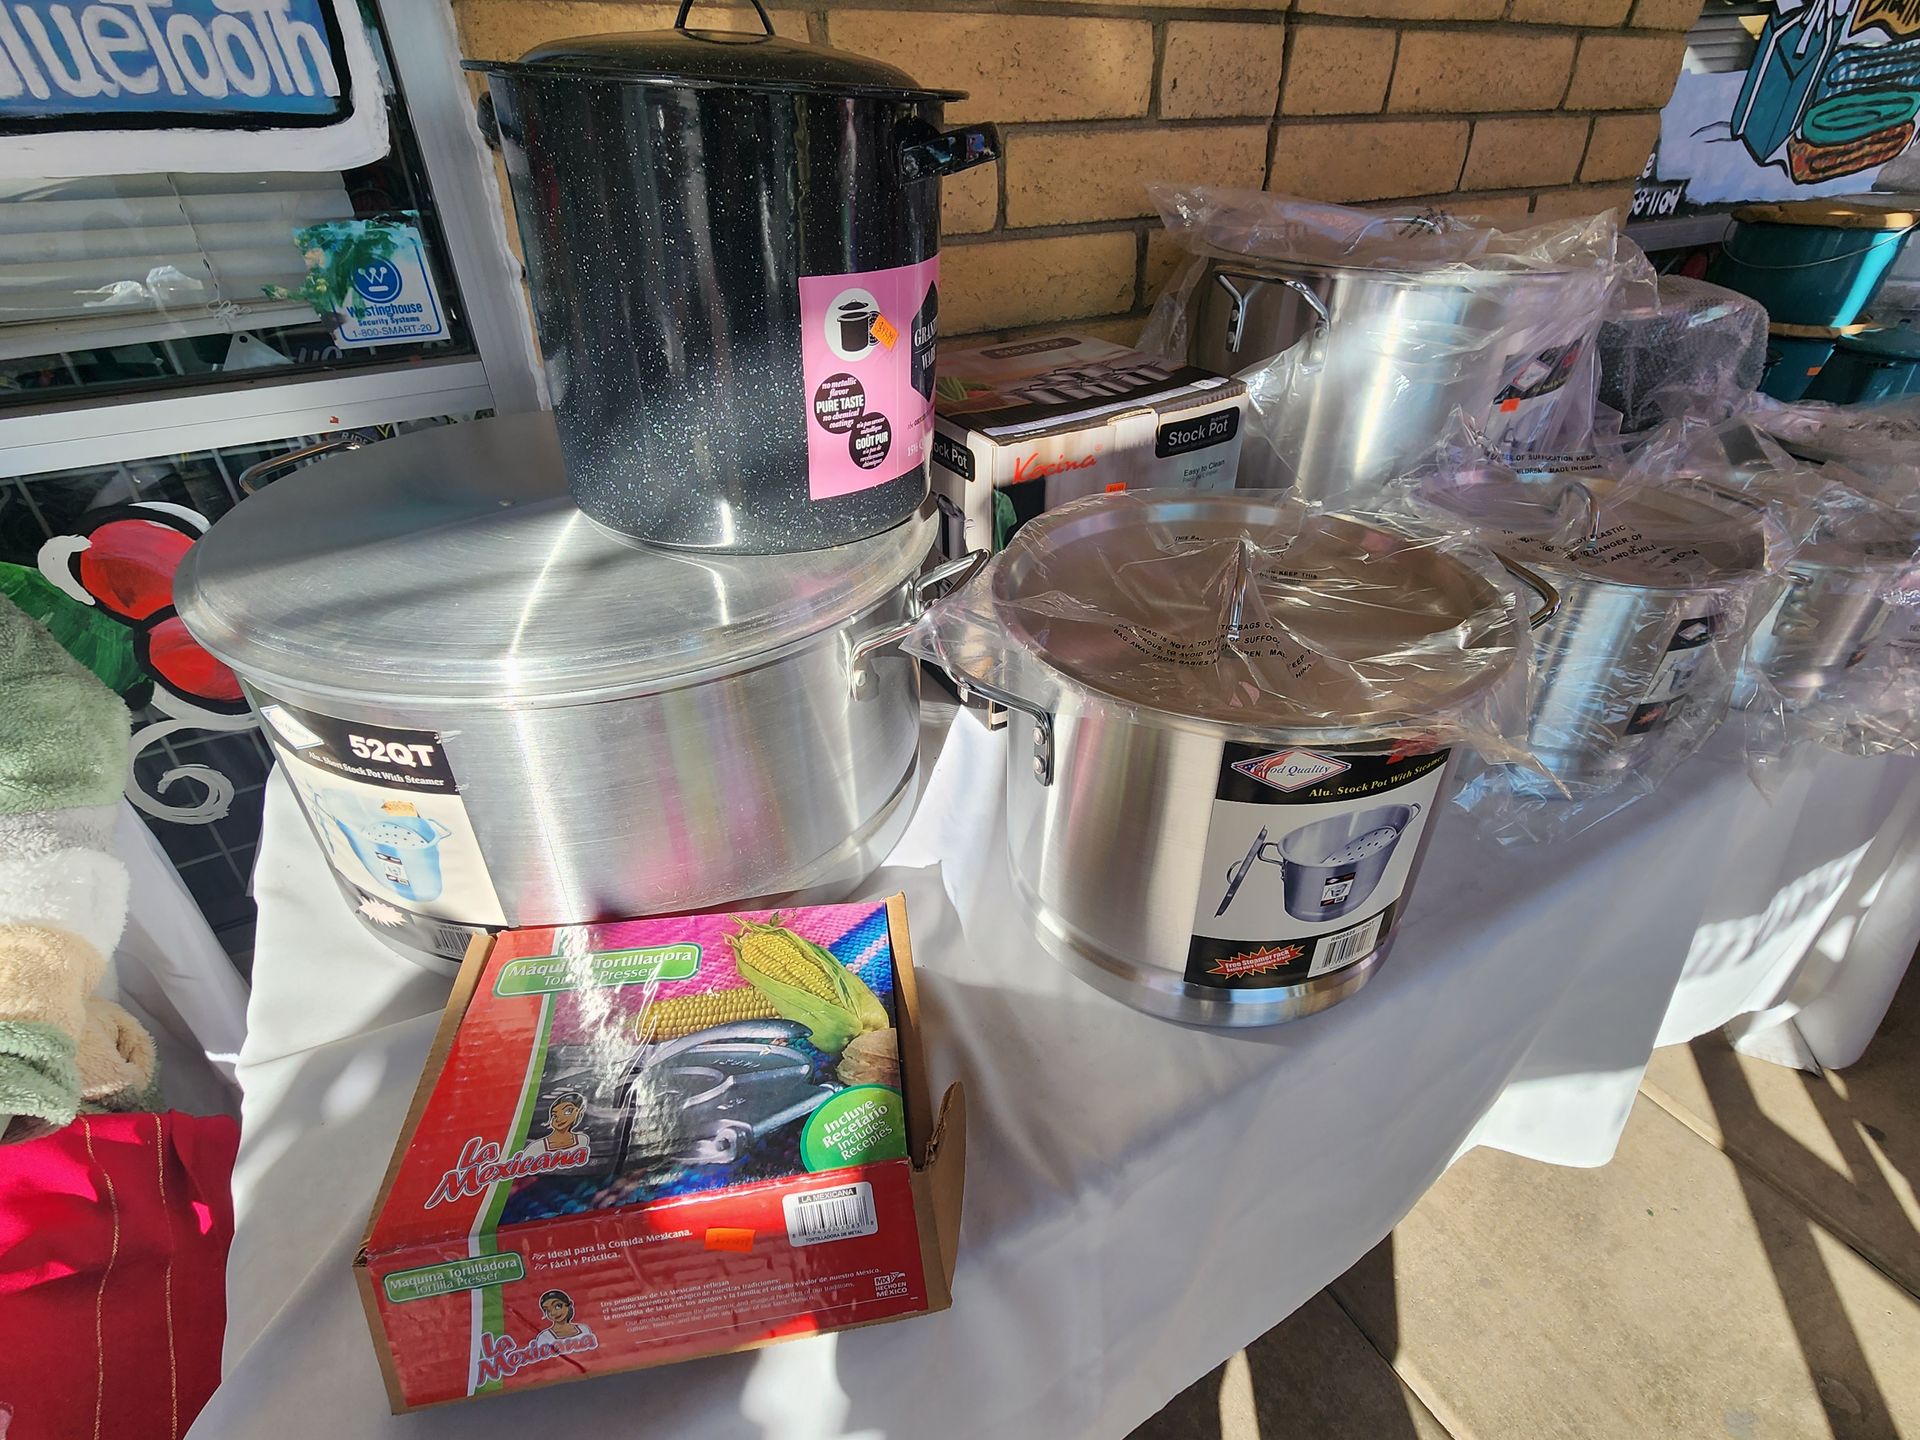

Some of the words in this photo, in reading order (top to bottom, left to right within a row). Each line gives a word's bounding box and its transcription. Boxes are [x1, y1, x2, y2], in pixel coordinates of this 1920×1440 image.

[352, 323, 432, 338] 1-800-SMART-20
[358, 318, 389, 327] Security
[390, 315, 420, 325] Systems
[831, 377, 857, 388] metallic
[828, 388, 849, 399] flavor
[816, 399, 840, 413] PURE
[840, 395, 864, 410] TASTE
[832, 408, 860, 420] chemical
[829, 420, 854, 429] coatings
[1168, 425, 1206, 446] Stock
[1208, 419, 1228, 437] Pot
[856, 434, 875, 450] GOÛT
[875, 431, 889, 444] PUR
[952, 448, 968, 470] Pot
[1012, 453, 1096, 485] Kocina
[1183, 467, 1199, 477] Easy
[1201, 464, 1208, 472] to
[1208, 459, 1226, 469] Clean
[1590, 524, 1626, 540] PLASTIC
[1592, 537, 1629, 555] DANGER
[1610, 552, 1629, 562] AND
[1113, 628, 1129, 642] BAG
[1130, 641, 1150, 655] AWAY
[1152, 653, 1175, 663] FROM
[1141, 627, 1158, 638] BAG
[1160, 635, 1168, 643] IS
[1169, 640, 1187, 650] NOT
[1197, 639, 1213, 647] TOY
[1237, 622, 1260, 631] BAGS
[348, 735, 434, 768] 52QT
[323, 756, 344, 770] Short
[343, 763, 368, 776] Stock
[366, 768, 381, 780] Pot
[381, 771, 404, 782] With
[405, 775, 444, 786] Steamer
[1286, 764, 1331, 777] Quality
[1309, 788, 1334, 798] Alu.
[1337, 783, 1368, 795] Stock
[1370, 778, 1388, 790] Pot
[1390, 770, 1413, 785] With
[1413, 754, 1446, 776] Steamer
[594, 950, 692, 970] Tortilladora
[1225, 960, 1242, 969] Free
[1242, 955, 1273, 967] Steamer
[1273, 949, 1291, 961] rack
[600, 965, 656, 979] Presser
[822, 1105, 888, 1148] Recetario
[823, 1100, 875, 1134] Incluye
[837, 1119, 886, 1151] Includes
[841, 1126, 893, 1161] Recepies
[456, 1136, 500, 1172] La
[424, 1147, 590, 1210] Mexicana
[800, 1195, 812, 1204] LA
[812, 1188, 854, 1202] MEXICANA
[547, 1248, 571, 1259] Ideal
[574, 1245, 595, 1259] para
[597, 1242, 606, 1251] la
[608, 1237, 644, 1250] Comida
[646, 1229, 693, 1243] Mexicana.
[806, 1232, 841, 1242] TORTILLADORA
[848, 1229, 863, 1237] METAL
[448, 1258, 517, 1279] Tortilladora
[550, 1258, 571, 1269] Fácil
[573, 1258, 579, 1267] y
[582, 1251, 621, 1263] Práctica.
[415, 1281, 454, 1296] Tortilla
[456, 1272, 500, 1287] Presser
[875, 1276, 890, 1286] MX
[875, 1282, 897, 1292] HECHO
[898, 1281, 907, 1289] EN
[601, 1300, 613, 1308] Los
[614, 1294, 648, 1307] productos
[649, 1290, 658, 1299] de
[669, 1285, 701, 1296] Mexicana
[703, 1279, 730, 1290] reflejan
[603, 1313, 611, 1321] la
[612, 1308, 644, 1321] nostalgia
[645, 1306, 655, 1314] de
[656, 1305, 663, 1313] la
[698, 1294, 723, 1305] amigos
[770, 1283, 794, 1296] orgullo
[801, 1278, 818, 1286] valor
[819, 1275, 828, 1283] de
[830, 1271, 854, 1281] nuestro
[611, 1302, 636, 1313] sentido
[701, 1289, 711, 1297] de
[712, 1284, 741, 1295] nuestras
[876, 1287, 908, 1298] MÉXICO
[480, 1332, 517, 1358] La
[476, 1333, 598, 1387] Mexicana
